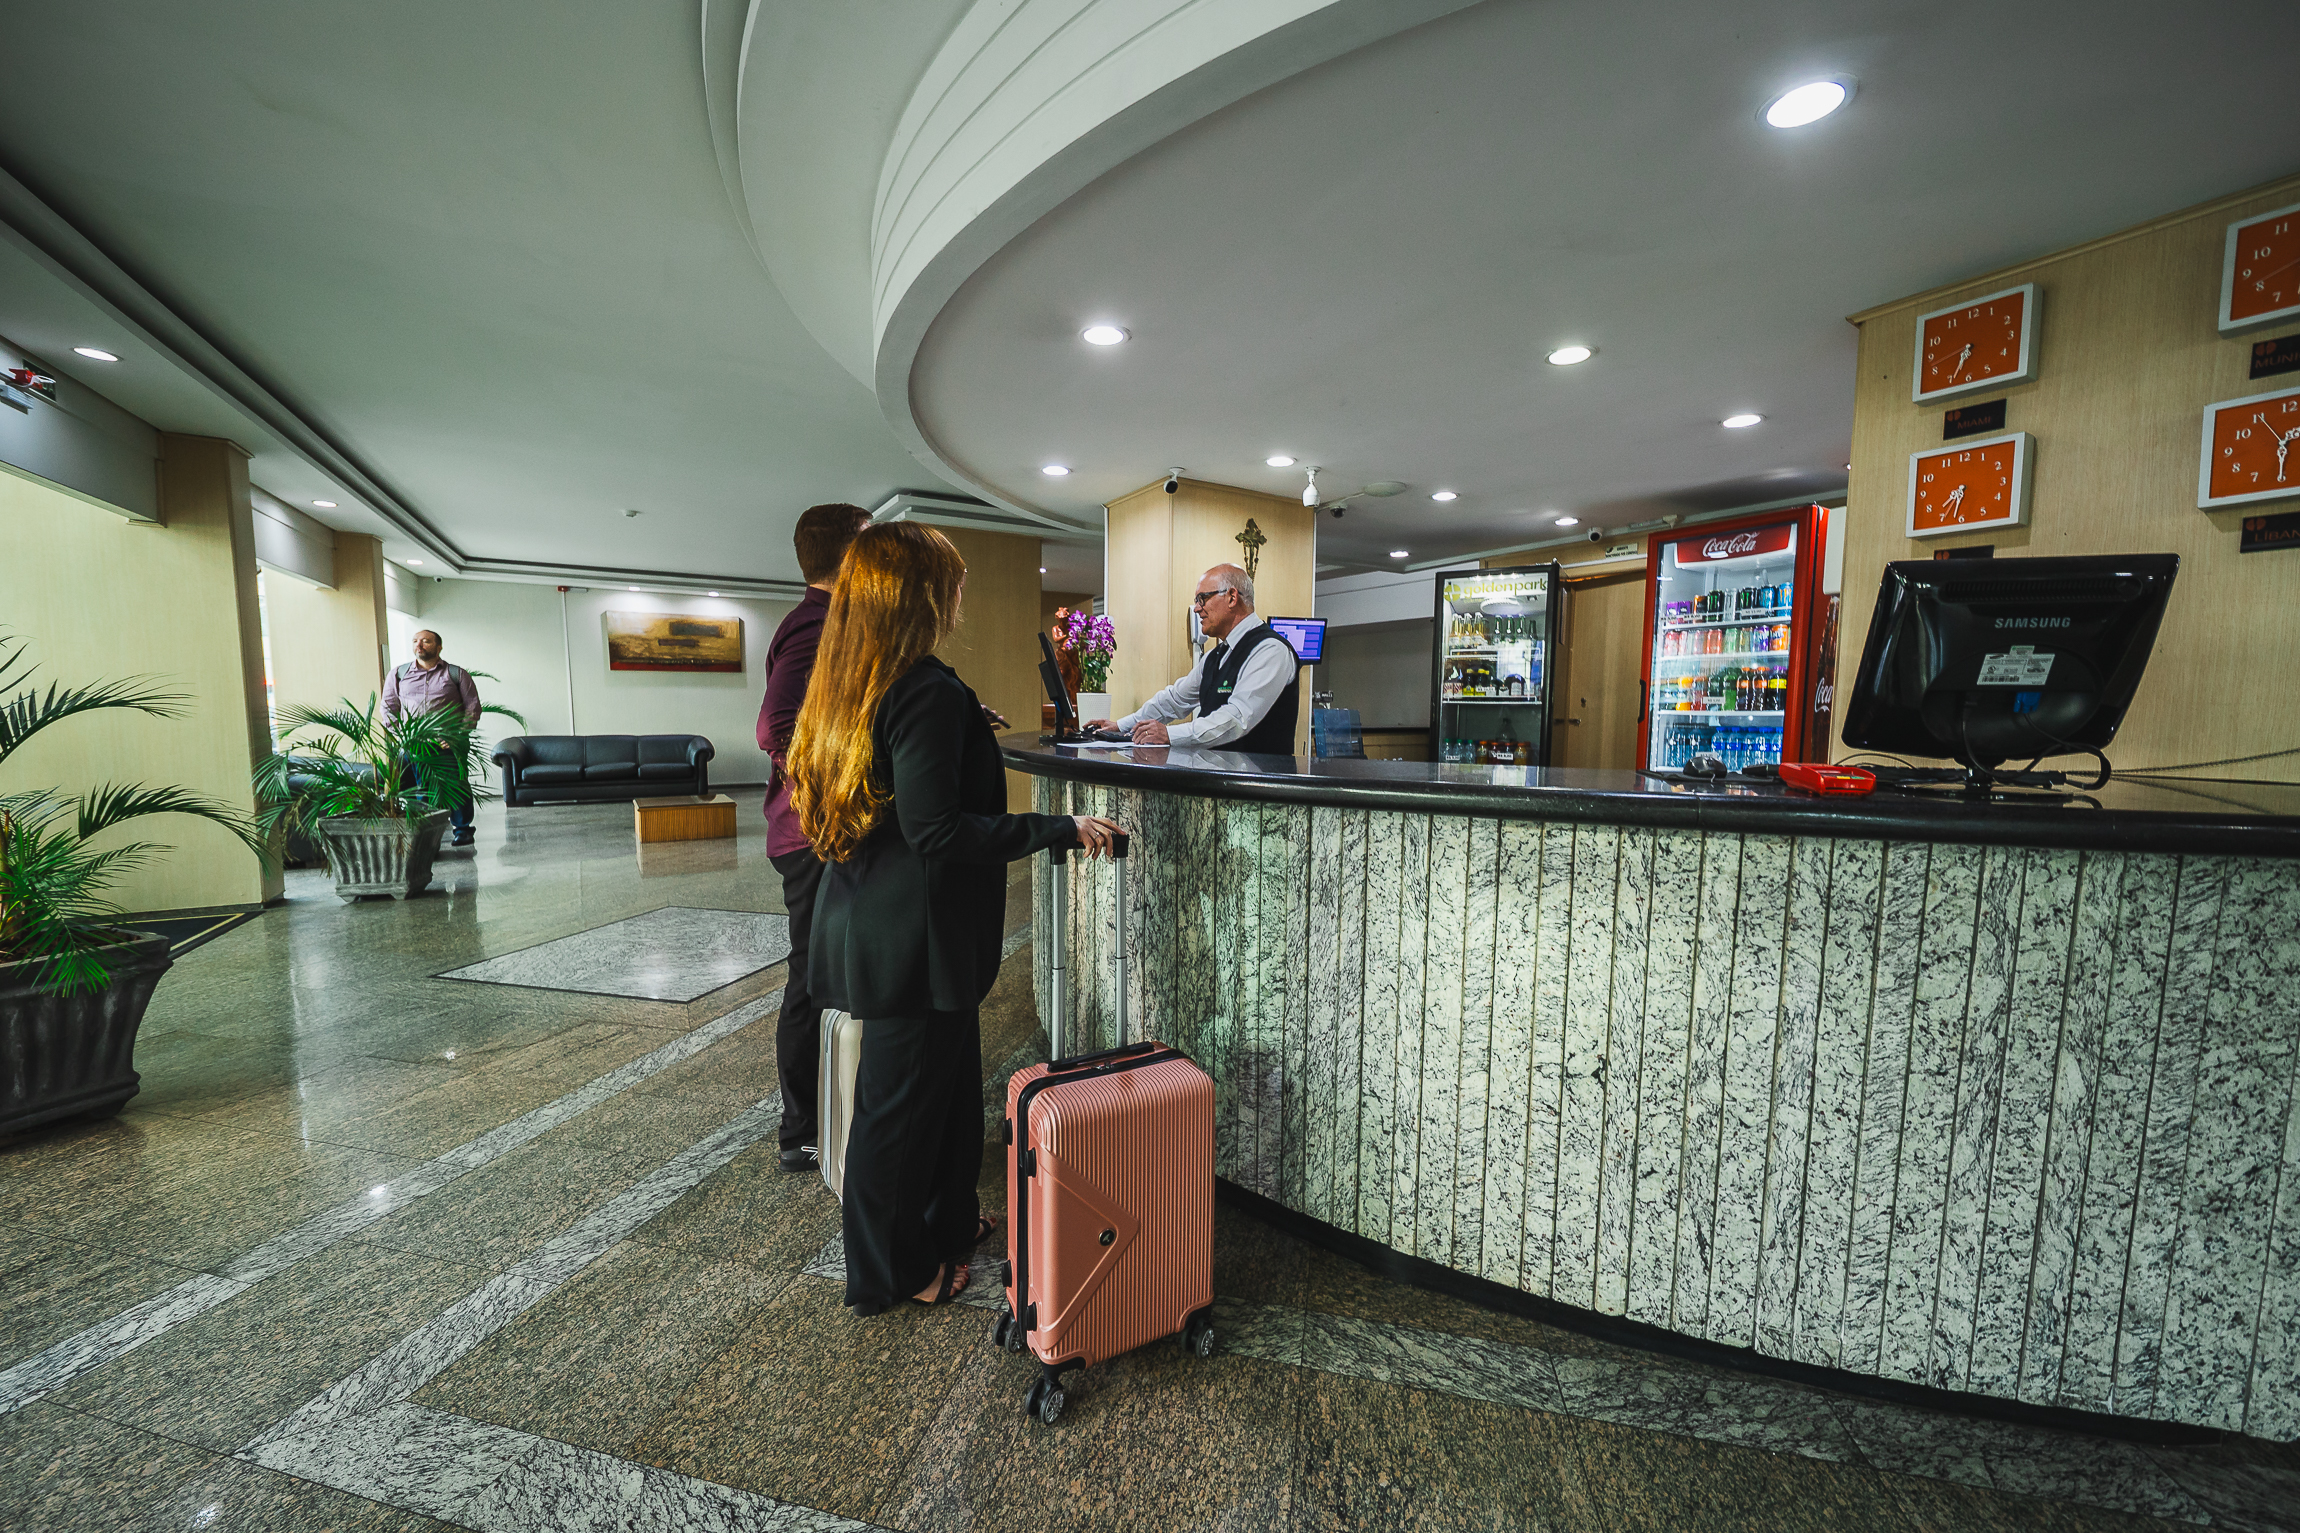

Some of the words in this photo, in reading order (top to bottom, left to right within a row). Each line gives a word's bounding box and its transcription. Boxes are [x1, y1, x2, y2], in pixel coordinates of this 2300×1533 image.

[2275, 222, 2288, 235] 11
[2253, 246, 2271, 260] 10
[2243, 268, 2252, 280] 9
[2255, 280, 2265, 292] 8
[2272, 291, 2281, 302] 7
[1968, 308, 1980, 319] 12
[1989, 307, 1994, 316] 1
[1948, 318, 1957, 329] 11
[2004, 315, 2011, 325] 2
[2007, 330, 2014, 340] 3
[1929, 336, 1941, 347] 10
[2000, 347, 2007, 357] 4
[1928, 353, 1935, 363] 9
[2255, 352, 2300, 368] MUNI
[1931, 366, 1939, 375] 8
[1984, 364, 1991, 374] 5
[1947, 375, 1953, 384] 7
[1965, 373, 1972, 382] 6
[2281, 401, 2298, 414] 12
[1957, 416, 1992, 430] MIAMI
[2235, 428, 2251, 440] 10
[1959, 452, 1971, 462] 12
[1981, 452, 1985, 461] 1
[2224, 447, 2233, 457] 9
[1942, 458, 1951, 468] 11
[1994, 461, 2002, 471] 2
[2232, 462, 2241, 473] 8
[1922, 473, 1934, 483] 10
[2000, 476, 2007, 486] 3
[2251, 472, 2259, 482] 7
[1920, 490, 1927, 499] 9
[1994, 492, 2001, 501] 4
[1926, 504, 1933, 513] 8
[1980, 506, 1987, 516] 5
[1939, 513, 1945, 522] 7
[1958, 514, 1965, 524] 6
[1702, 531, 1759, 557] Coca-Cola
[1995, 617, 2071, 628] SAMSUNG
